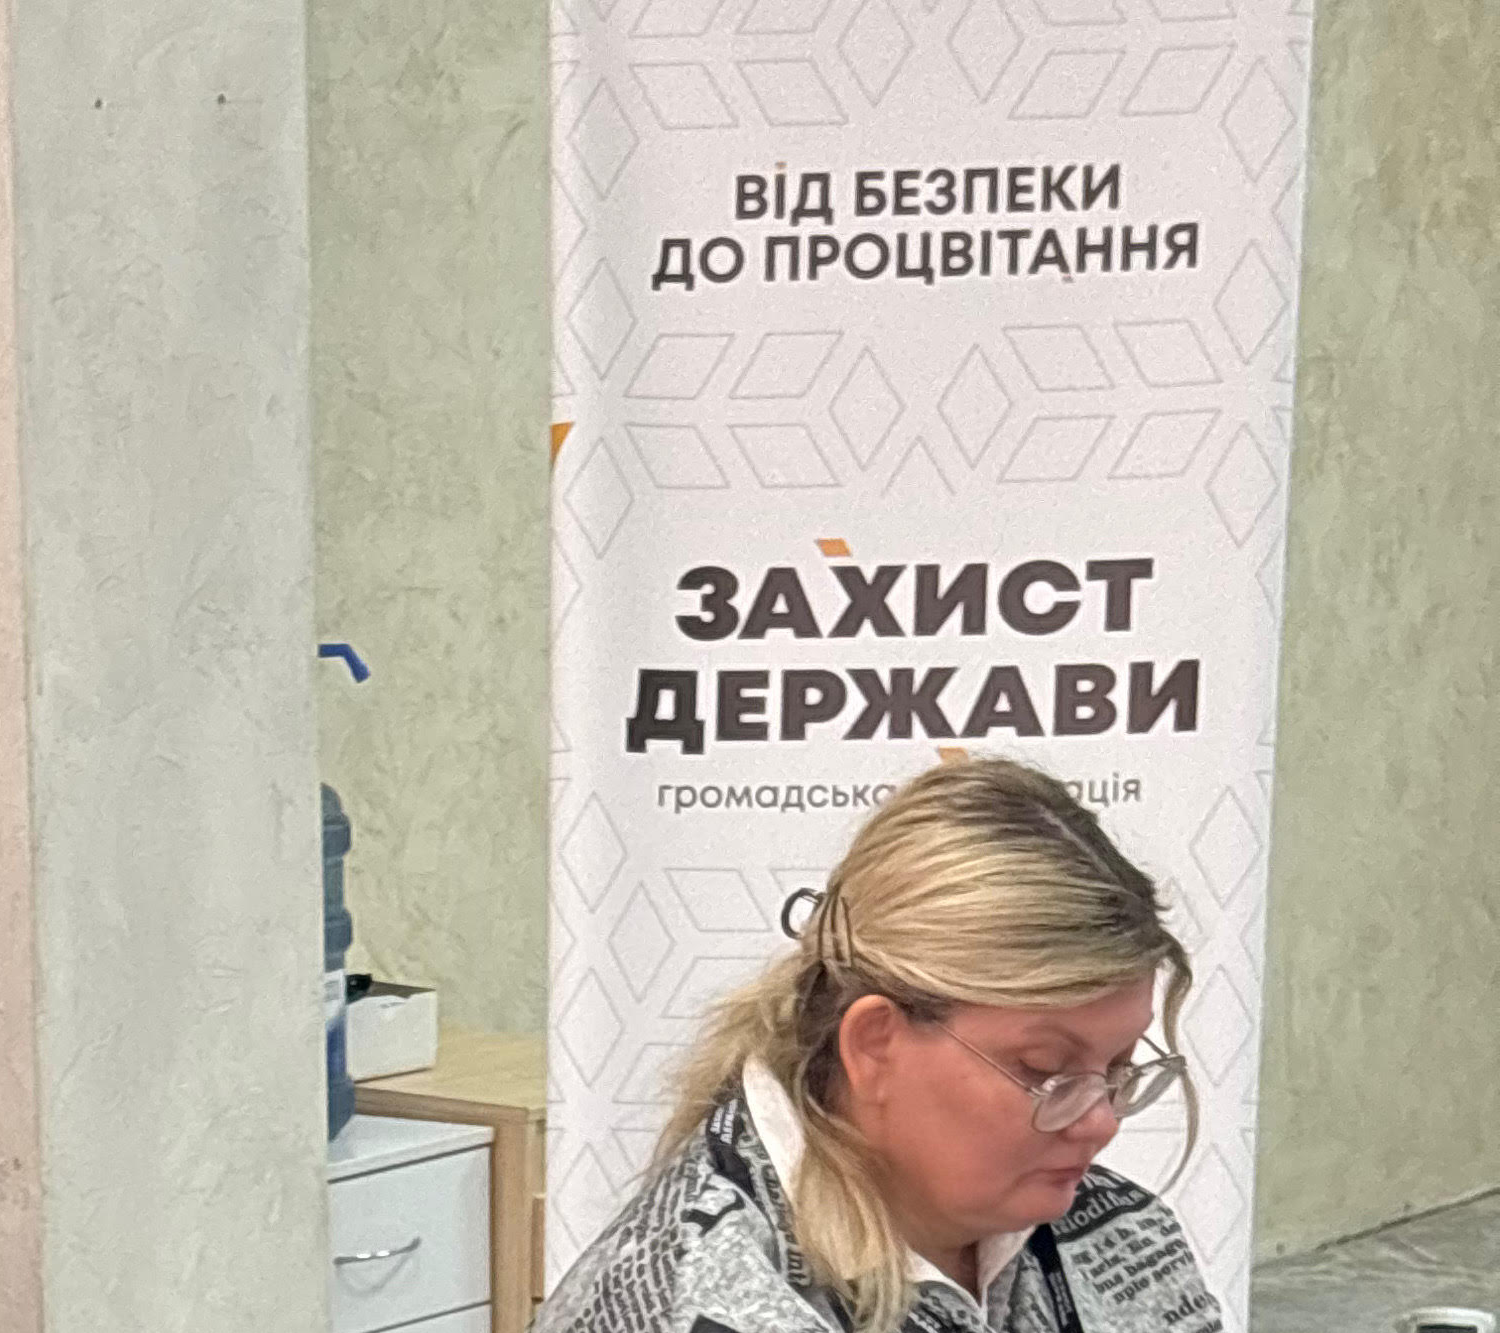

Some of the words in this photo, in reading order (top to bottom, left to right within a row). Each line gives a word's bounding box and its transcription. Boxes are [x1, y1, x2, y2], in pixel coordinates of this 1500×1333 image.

[736, 173, 833, 226] ВІД
[855, 164, 1120, 216] БЕЗПЕКИ
[652, 237, 744, 291] ДО
[765, 220, 1198, 285] ПРОЦВІТАННЯ
[676, 558, 1154, 641] ЗАХИСТ
[626, 659, 1200, 754] ДЕРЖАВИ
[656, 780, 899, 814] громадська
